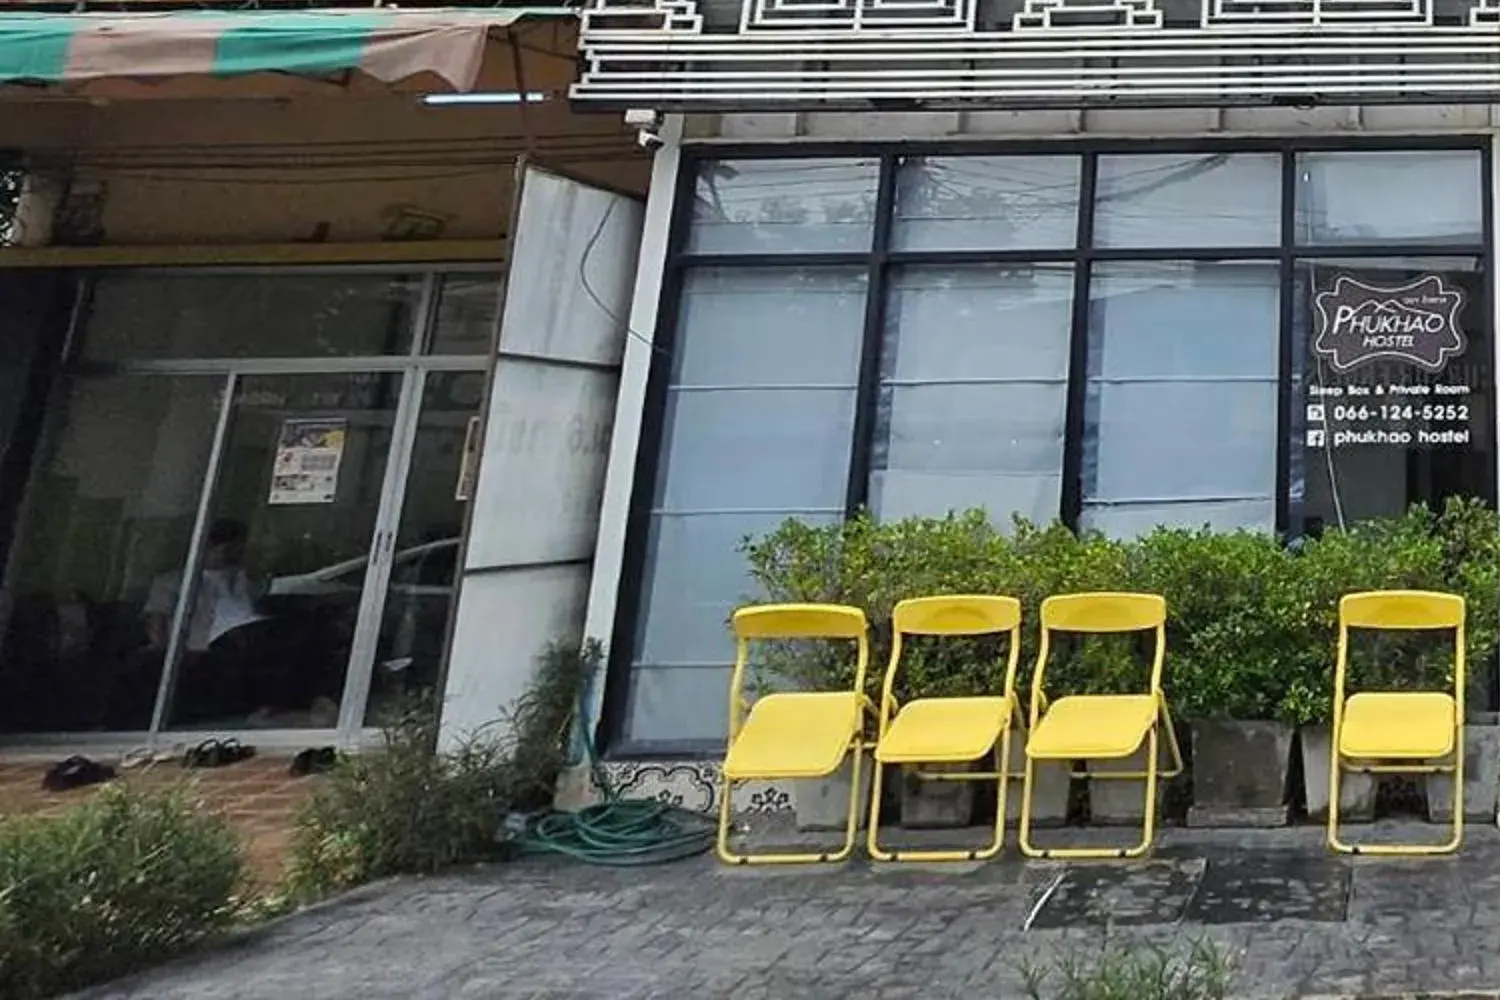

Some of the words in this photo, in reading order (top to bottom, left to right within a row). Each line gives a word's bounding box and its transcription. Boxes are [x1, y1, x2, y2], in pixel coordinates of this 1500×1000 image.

[1332, 305, 1445, 335] PHUKHAO
[1362, 335, 1415, 348] HOSTEL
[1434, 384, 1471, 396] Room
[1333, 404, 1470, 421] 066-124-5252
[1333, 429, 1412, 448] phukhao
[1417, 429, 1470, 443] hostel
